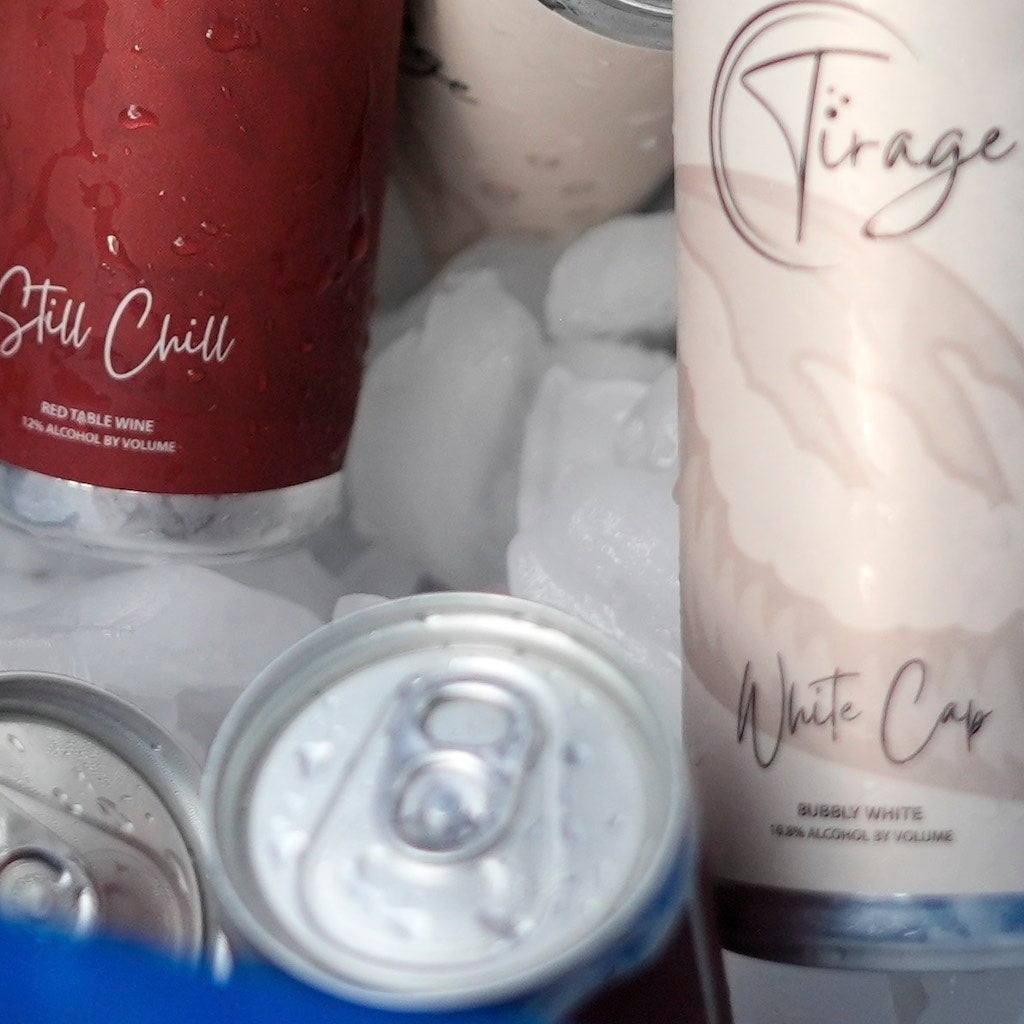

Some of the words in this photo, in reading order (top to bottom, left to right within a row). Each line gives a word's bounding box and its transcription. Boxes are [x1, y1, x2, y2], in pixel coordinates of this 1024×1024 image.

[740, 46, 1017, 243] Tirage
[104, 287, 235, 380] Chill
[22, 416, 44, 432] 12%
[45, 423, 101, 445] ALCOHOL
[103, 434, 120, 447] BY
[121, 436, 176, 452] VOLUME
[41, 401, 68, 418] RED
[70, 407, 112, 428] TABLE
[115, 416, 154, 432] WINE
[737, 651, 862, 769] White
[880, 657, 993, 765] Cap
[797, 802, 860, 819] BUBBLY
[865, 805, 924, 820] WHITE
[807, 827, 870, 841] ALCOHOL
[874, 830, 891, 842] BY
[893, 830, 954, 843] VOLUME
